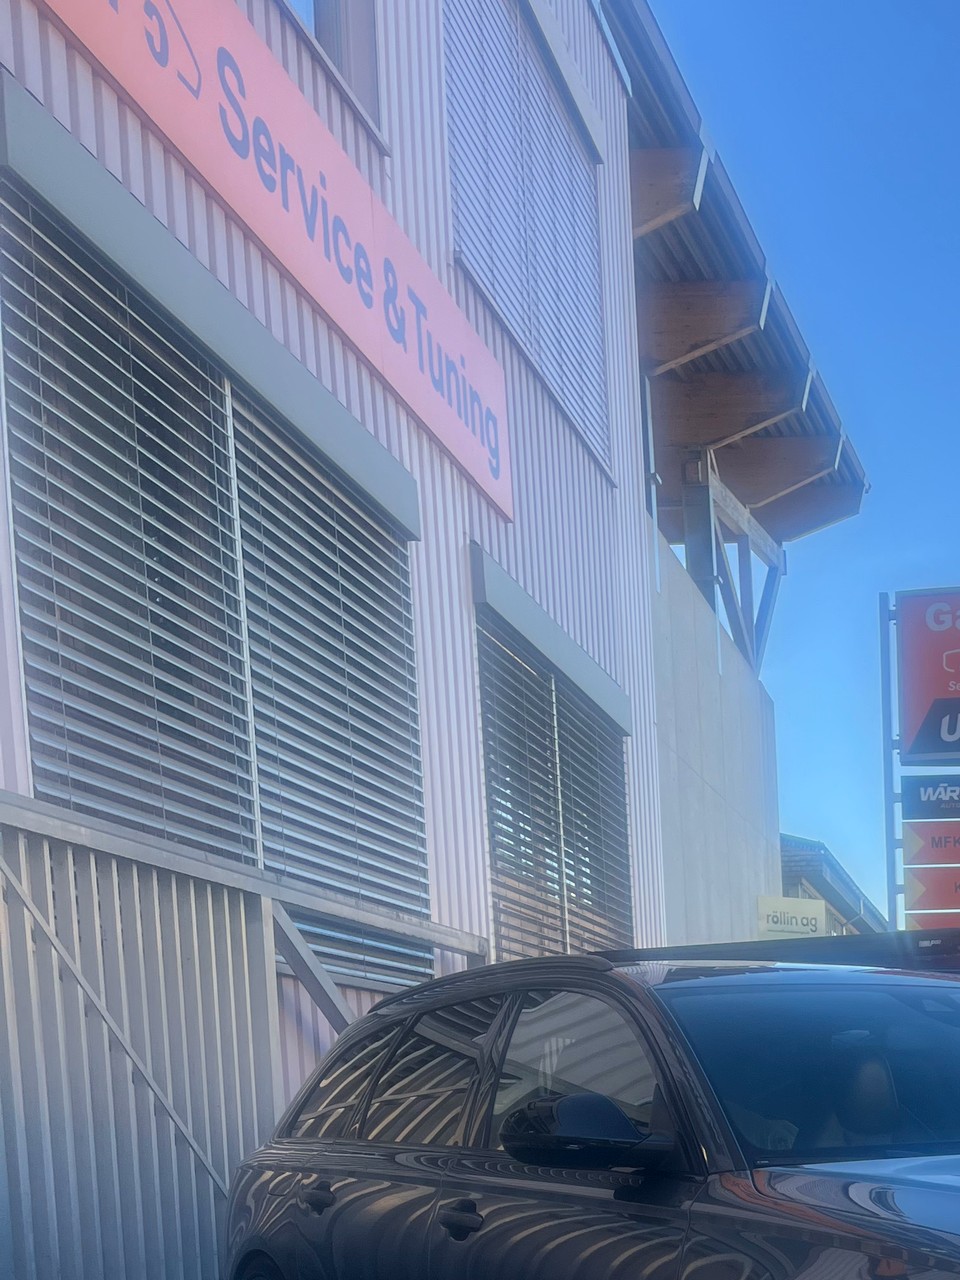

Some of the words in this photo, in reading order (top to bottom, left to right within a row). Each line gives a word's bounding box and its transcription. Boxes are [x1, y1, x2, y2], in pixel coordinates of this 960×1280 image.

[216, 46, 374, 309] Service
[382, 257, 408, 354] &
[407, 287, 501, 481] Tuning
[766, 910, 798, 927] röllin
[800, 916, 818, 933] ag
